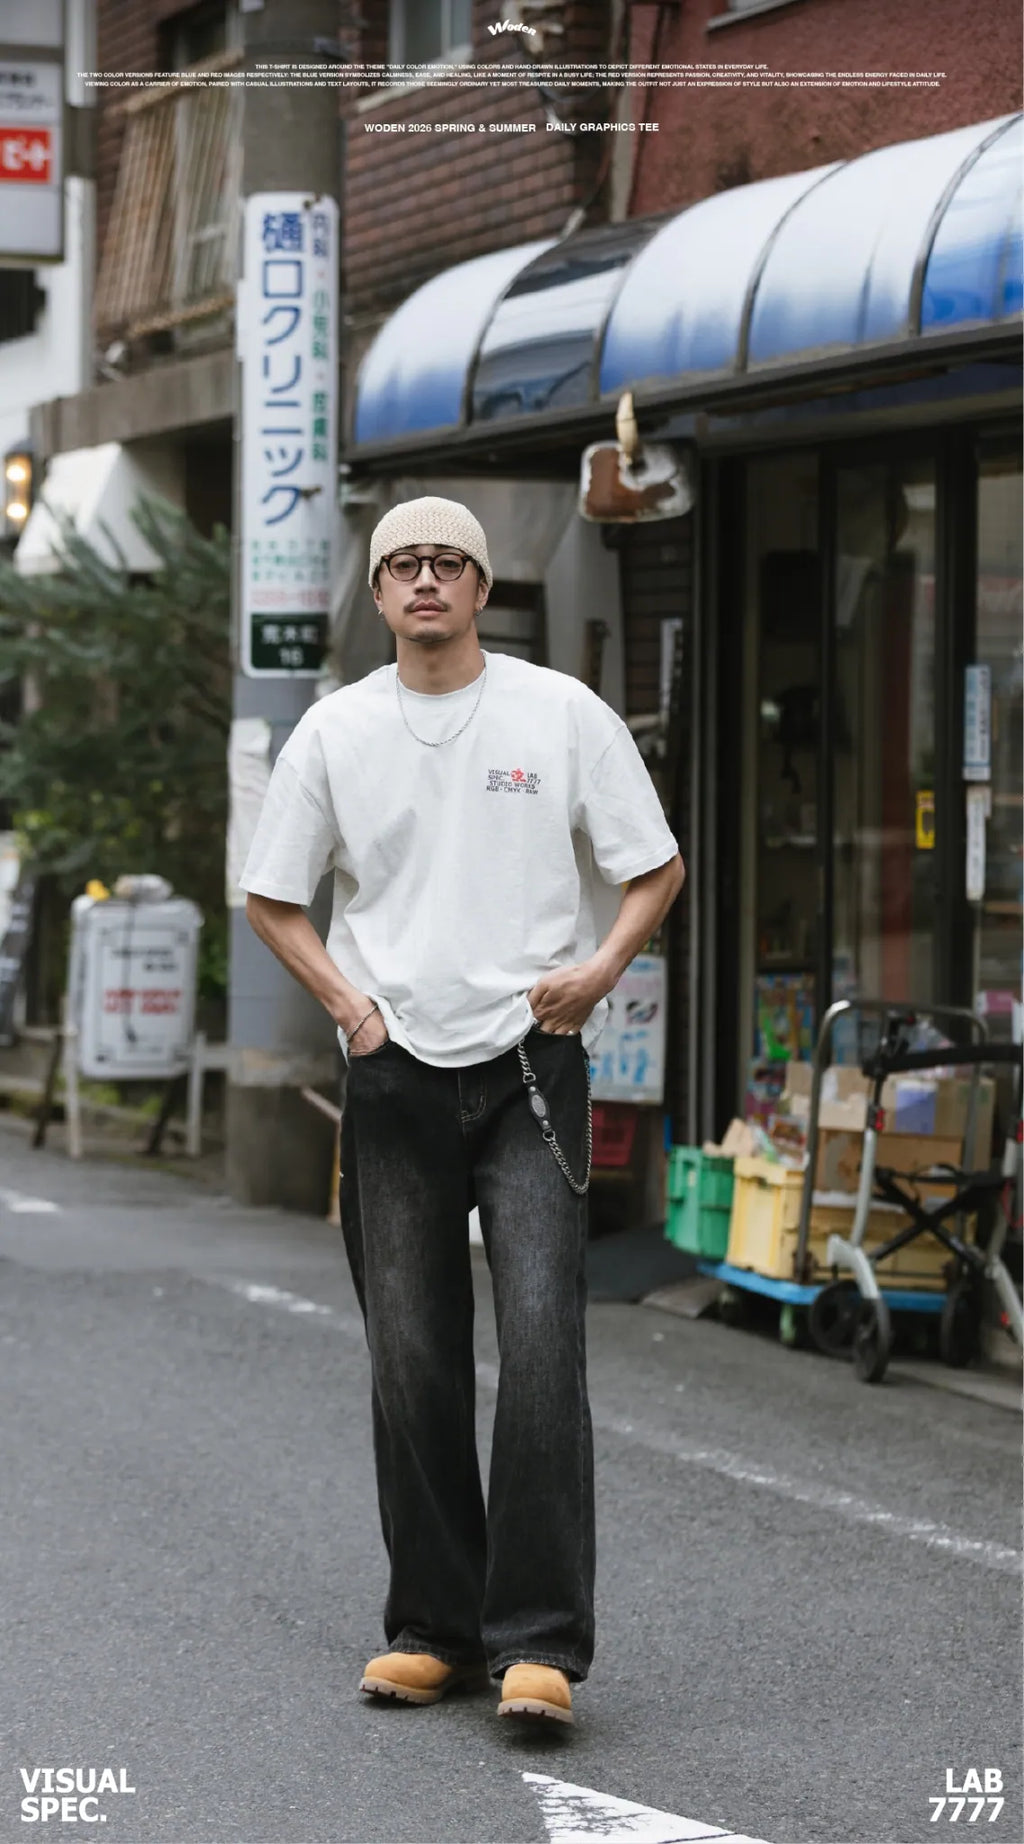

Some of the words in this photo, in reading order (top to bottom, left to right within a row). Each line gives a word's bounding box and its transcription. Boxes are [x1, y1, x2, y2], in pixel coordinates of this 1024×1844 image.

[262, 212, 303, 525] 樋口クリニック
